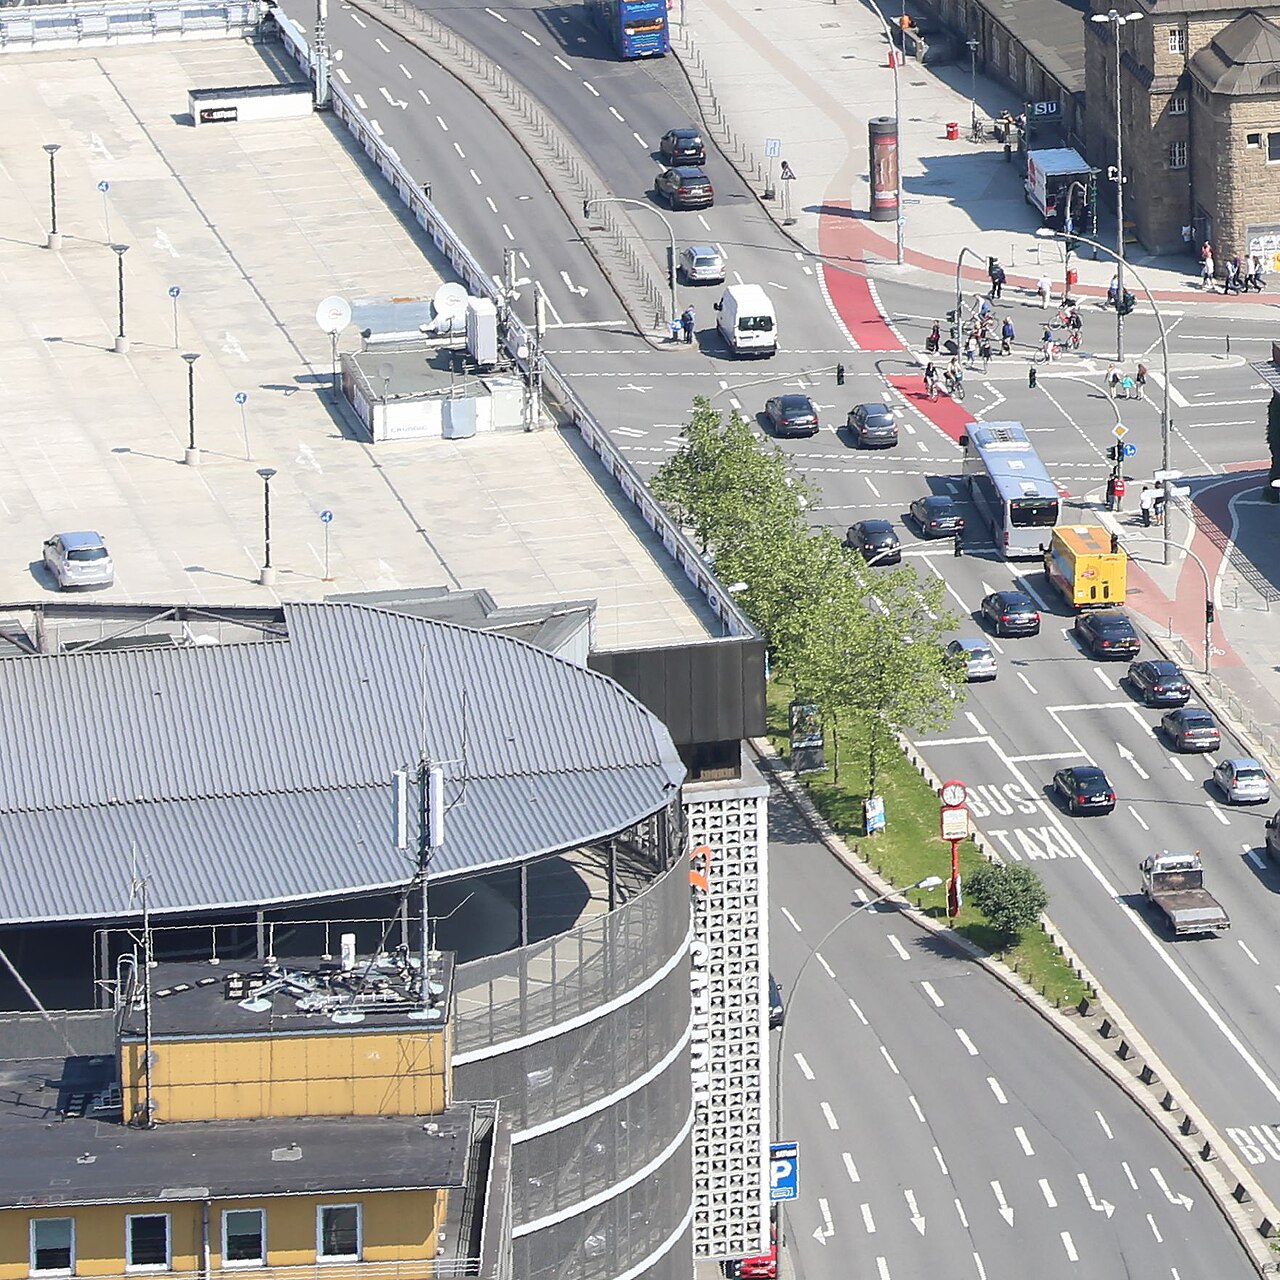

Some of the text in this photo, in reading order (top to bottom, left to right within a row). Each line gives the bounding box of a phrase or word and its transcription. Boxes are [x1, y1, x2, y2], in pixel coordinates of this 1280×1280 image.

[965, 784, 1037, 817] BUS
[988, 826, 1078, 861] TAXI
[771, 1159, 793, 1187] P
